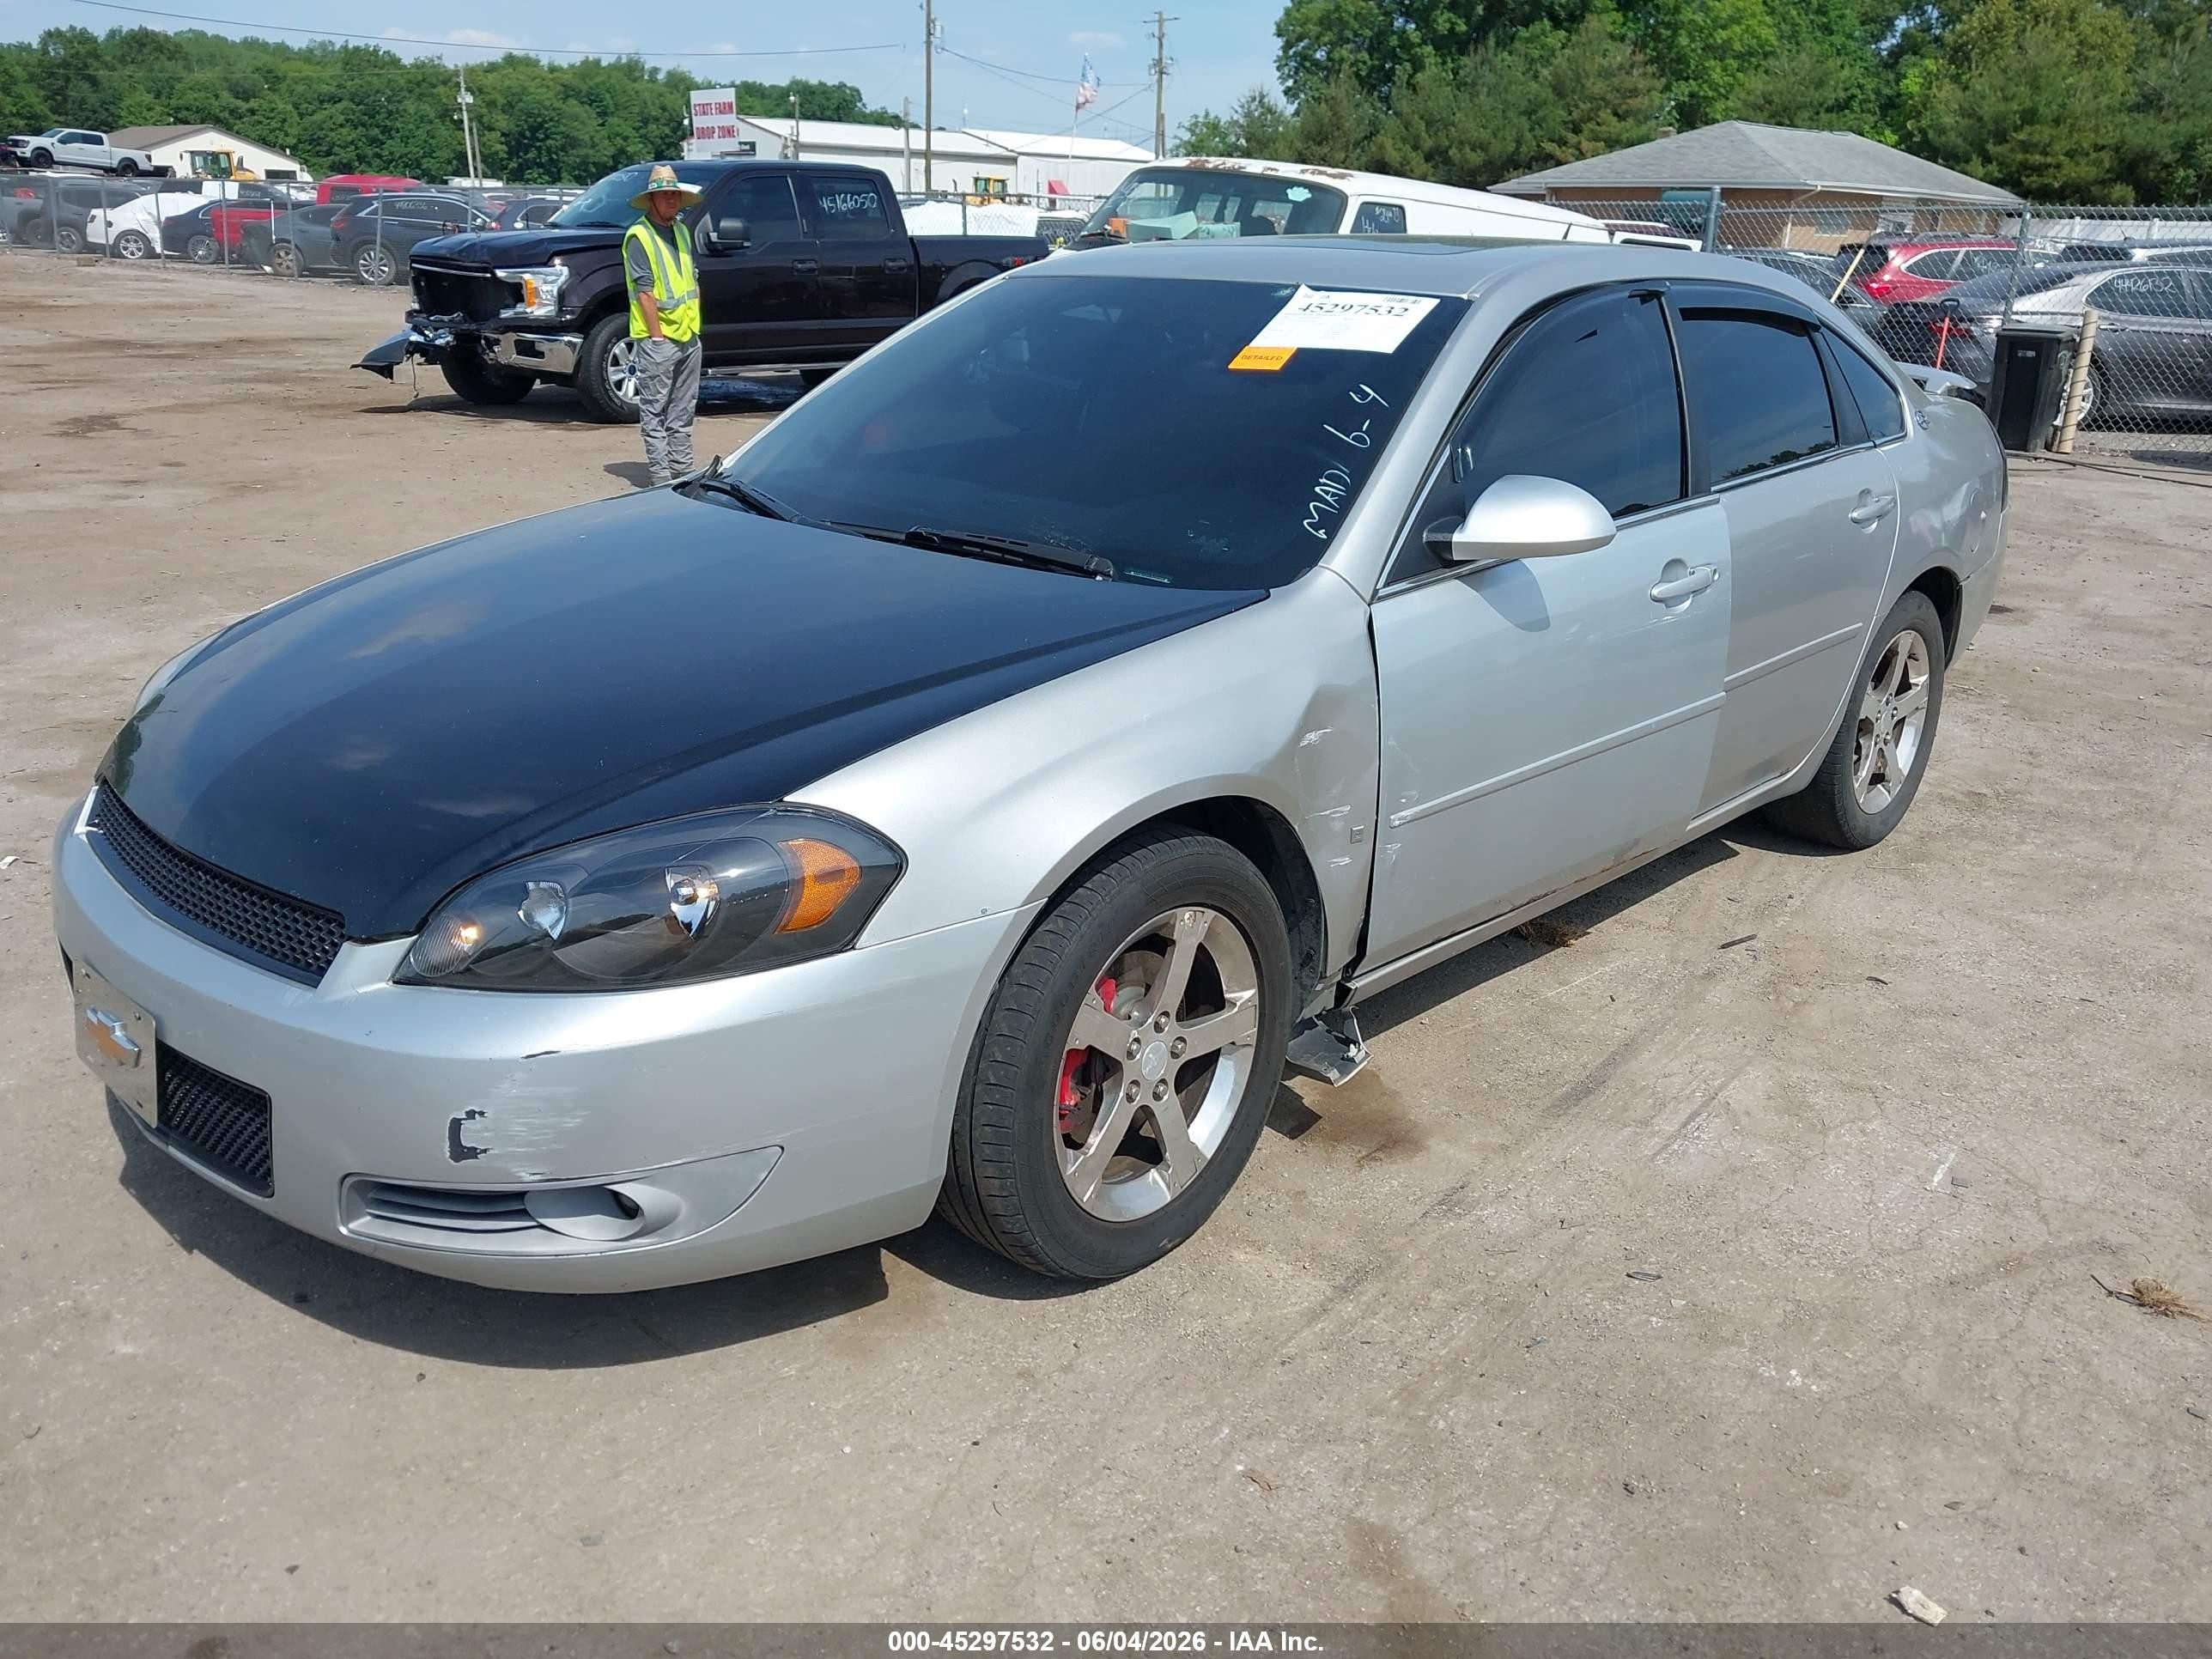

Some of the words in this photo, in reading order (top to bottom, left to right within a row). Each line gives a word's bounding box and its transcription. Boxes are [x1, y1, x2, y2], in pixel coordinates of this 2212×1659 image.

[693, 102, 714, 117] STATE
[714, 100, 733, 115] FARM
[696, 126, 715, 139] DROP
[717, 125, 736, 138] ZONE
[1298, 302, 1409, 317] 45297532
